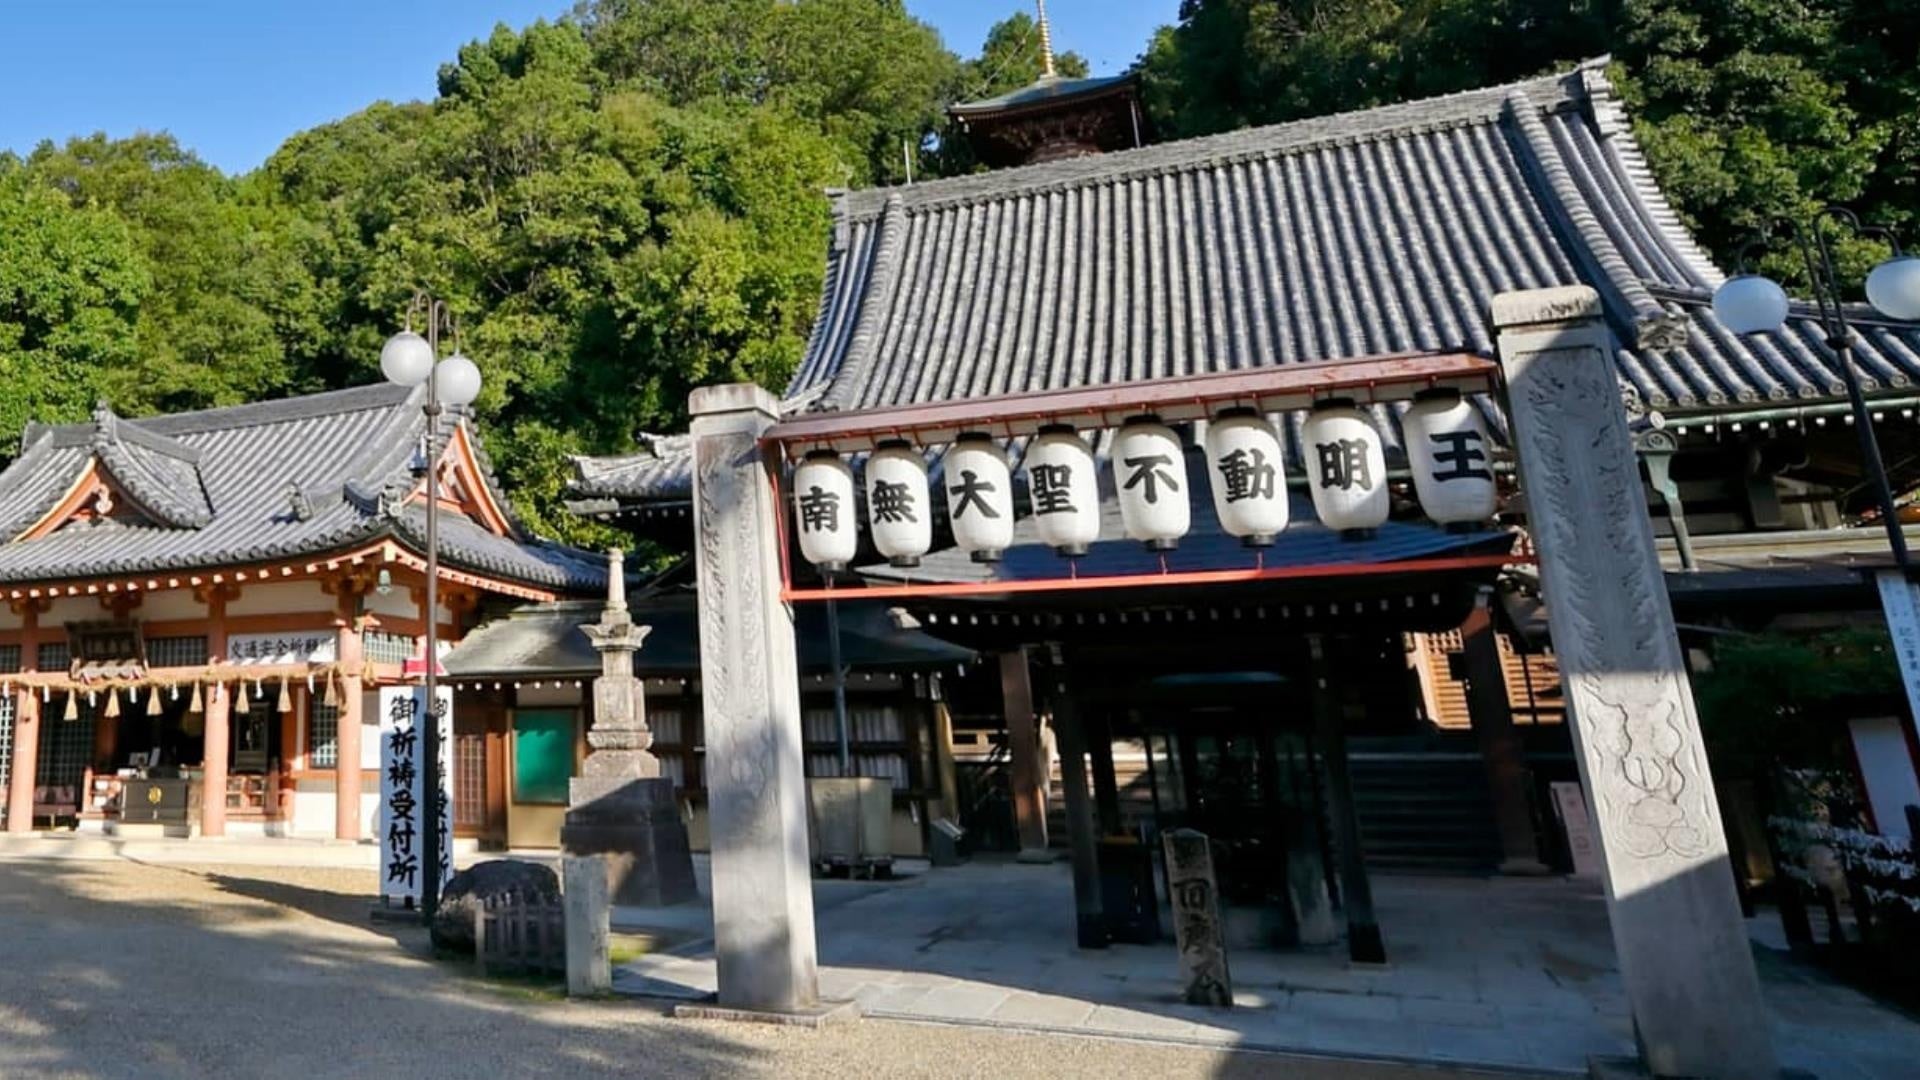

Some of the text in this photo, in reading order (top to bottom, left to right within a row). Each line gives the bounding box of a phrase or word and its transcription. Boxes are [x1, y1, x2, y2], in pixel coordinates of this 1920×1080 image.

[800, 430, 1492, 534] 南無大聖不動明王
